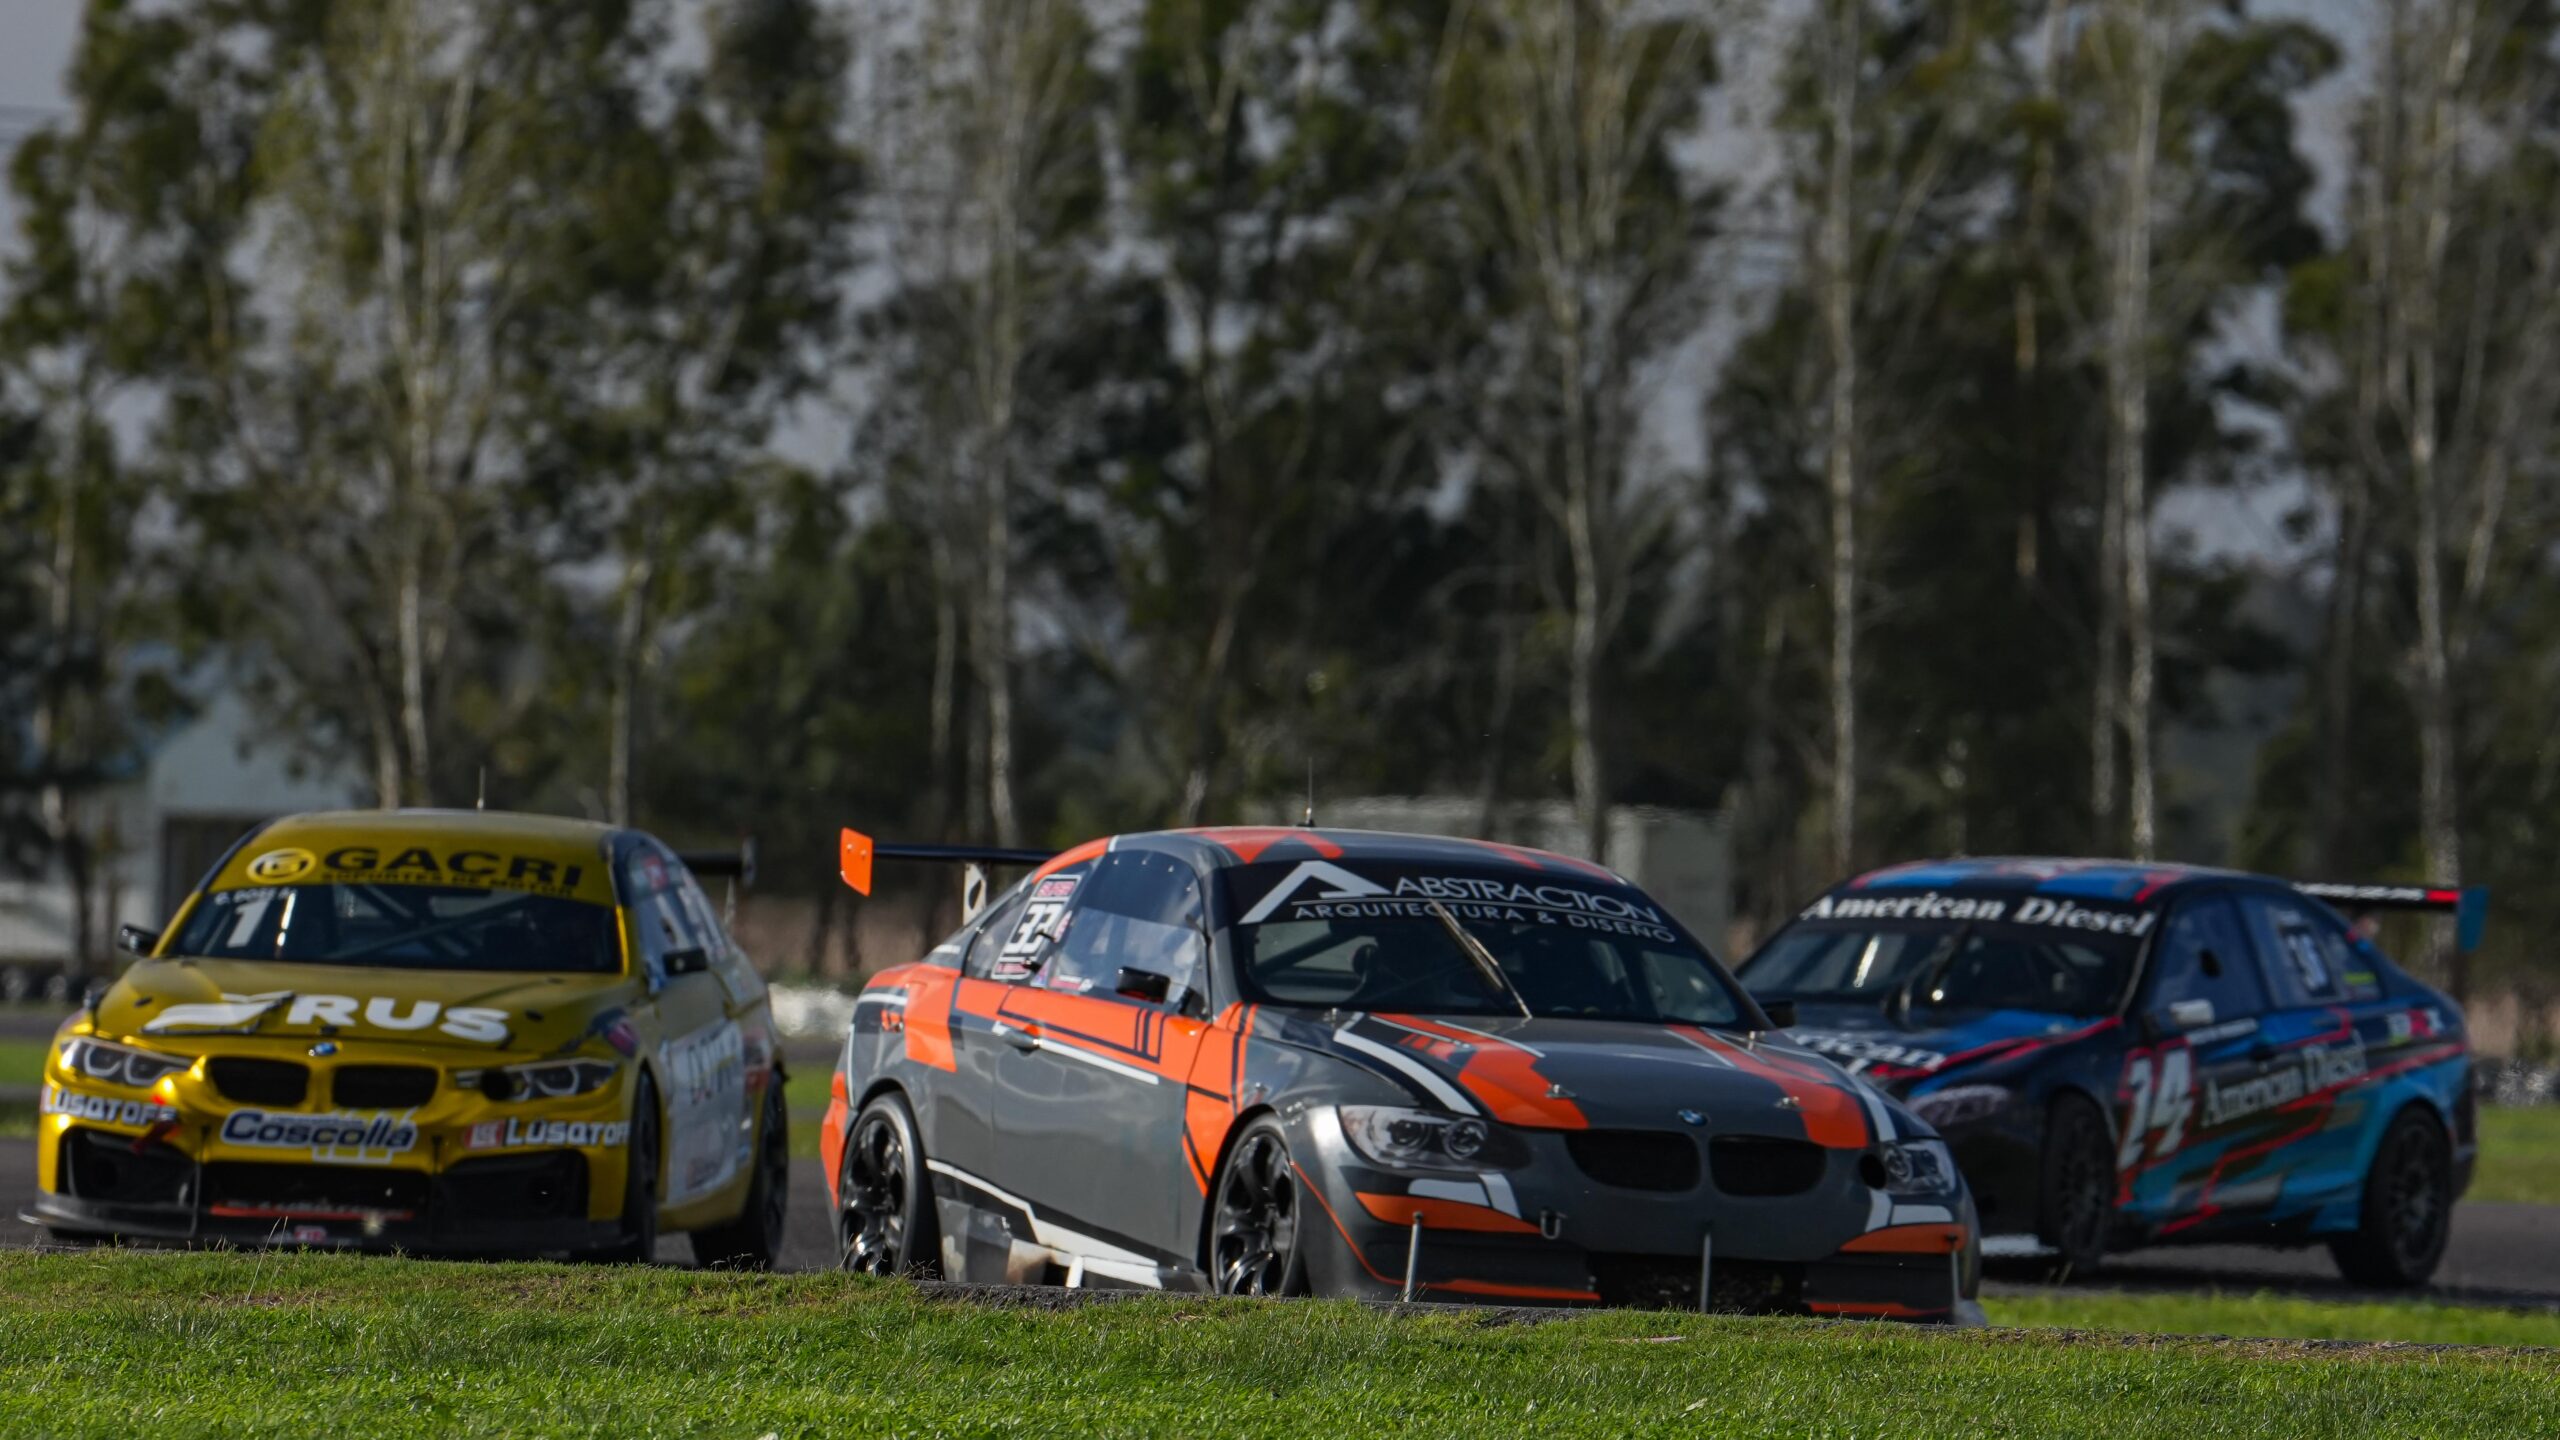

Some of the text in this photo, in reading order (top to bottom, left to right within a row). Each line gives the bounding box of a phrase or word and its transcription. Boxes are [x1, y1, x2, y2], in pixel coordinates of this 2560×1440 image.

[324, 848, 583, 887] GACRI
[227, 895, 273, 948] 1
[1294, 901, 1525, 921] ARQUITECTURA
[1536, 911, 1557, 924] &
[1395, 876, 1661, 923] ABSTRACTION
[1800, 891, 2156, 936] American Diesel
[287, 995, 510, 1042] RUS
[2202, 1065, 2303, 1127] American
[2304, 1029, 2368, 1092] Diesel
[2116, 1050, 2194, 1171] 24
